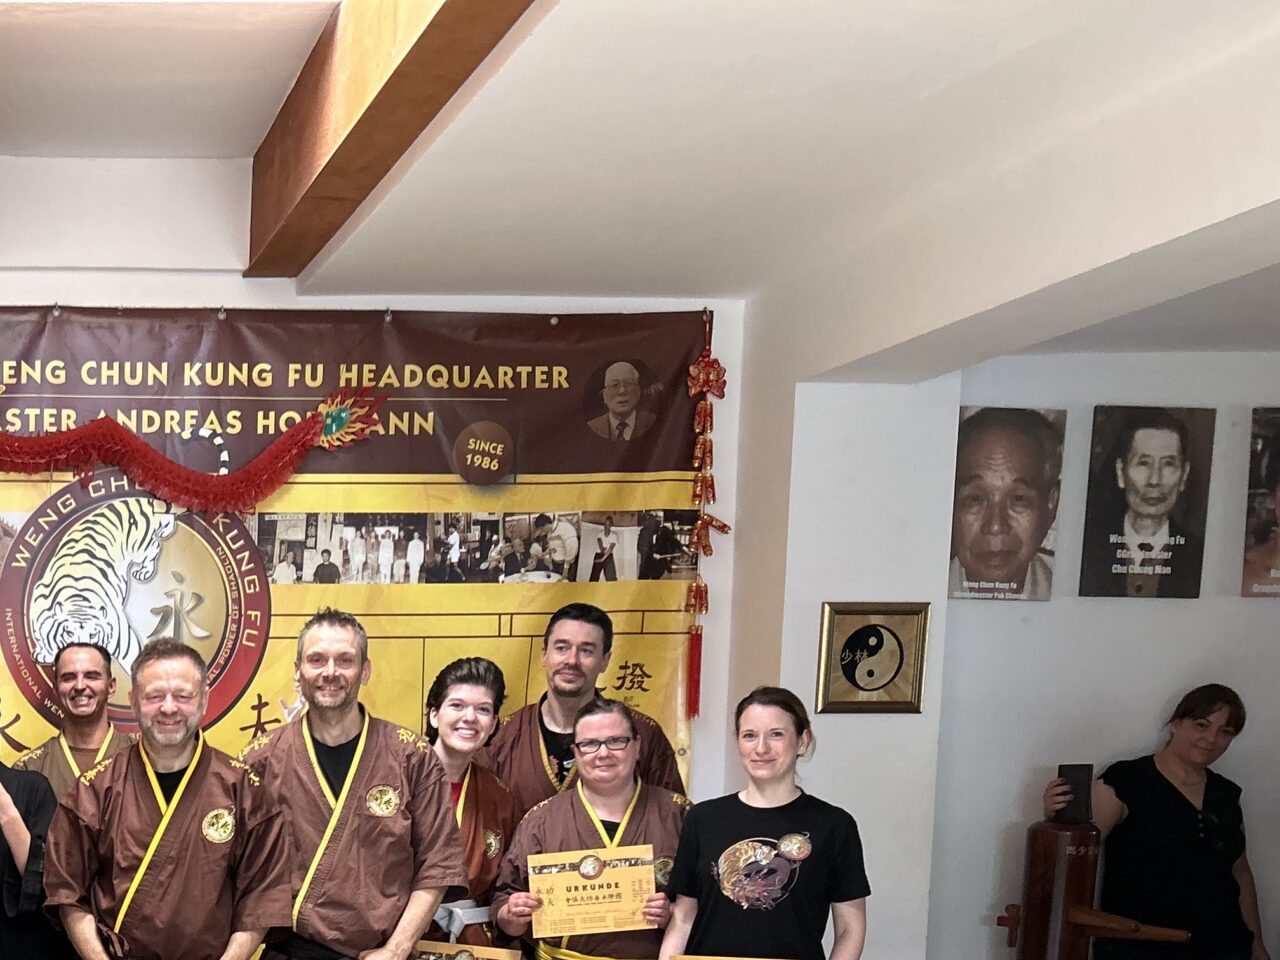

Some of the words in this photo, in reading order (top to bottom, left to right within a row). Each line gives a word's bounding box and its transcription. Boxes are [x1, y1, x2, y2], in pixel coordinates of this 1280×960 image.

[80, 360, 168, 386] CHUN
[183, 362, 273, 388] KUNG
[287, 363, 324, 388] FU
[339, 363, 569, 389] HEADQUARTER
[95, 408, 242, 435] NDREAS
[468, 438, 505, 456] SINCE
[466, 453, 499, 471] 1986
[11, 493, 76, 568] WENG
[212, 512, 260, 594] KUNG
[242, 610, 261, 647] FU
[216, 546, 239, 598] SHAOLIN
[231, 604, 239, 619] OF
[218, 622, 238, 665] POWER
[5, 608, 41, 699] INTERNATIONAL
[44, 698, 65, 719] WEN
[566, 882, 620, 892] URKUNDE
